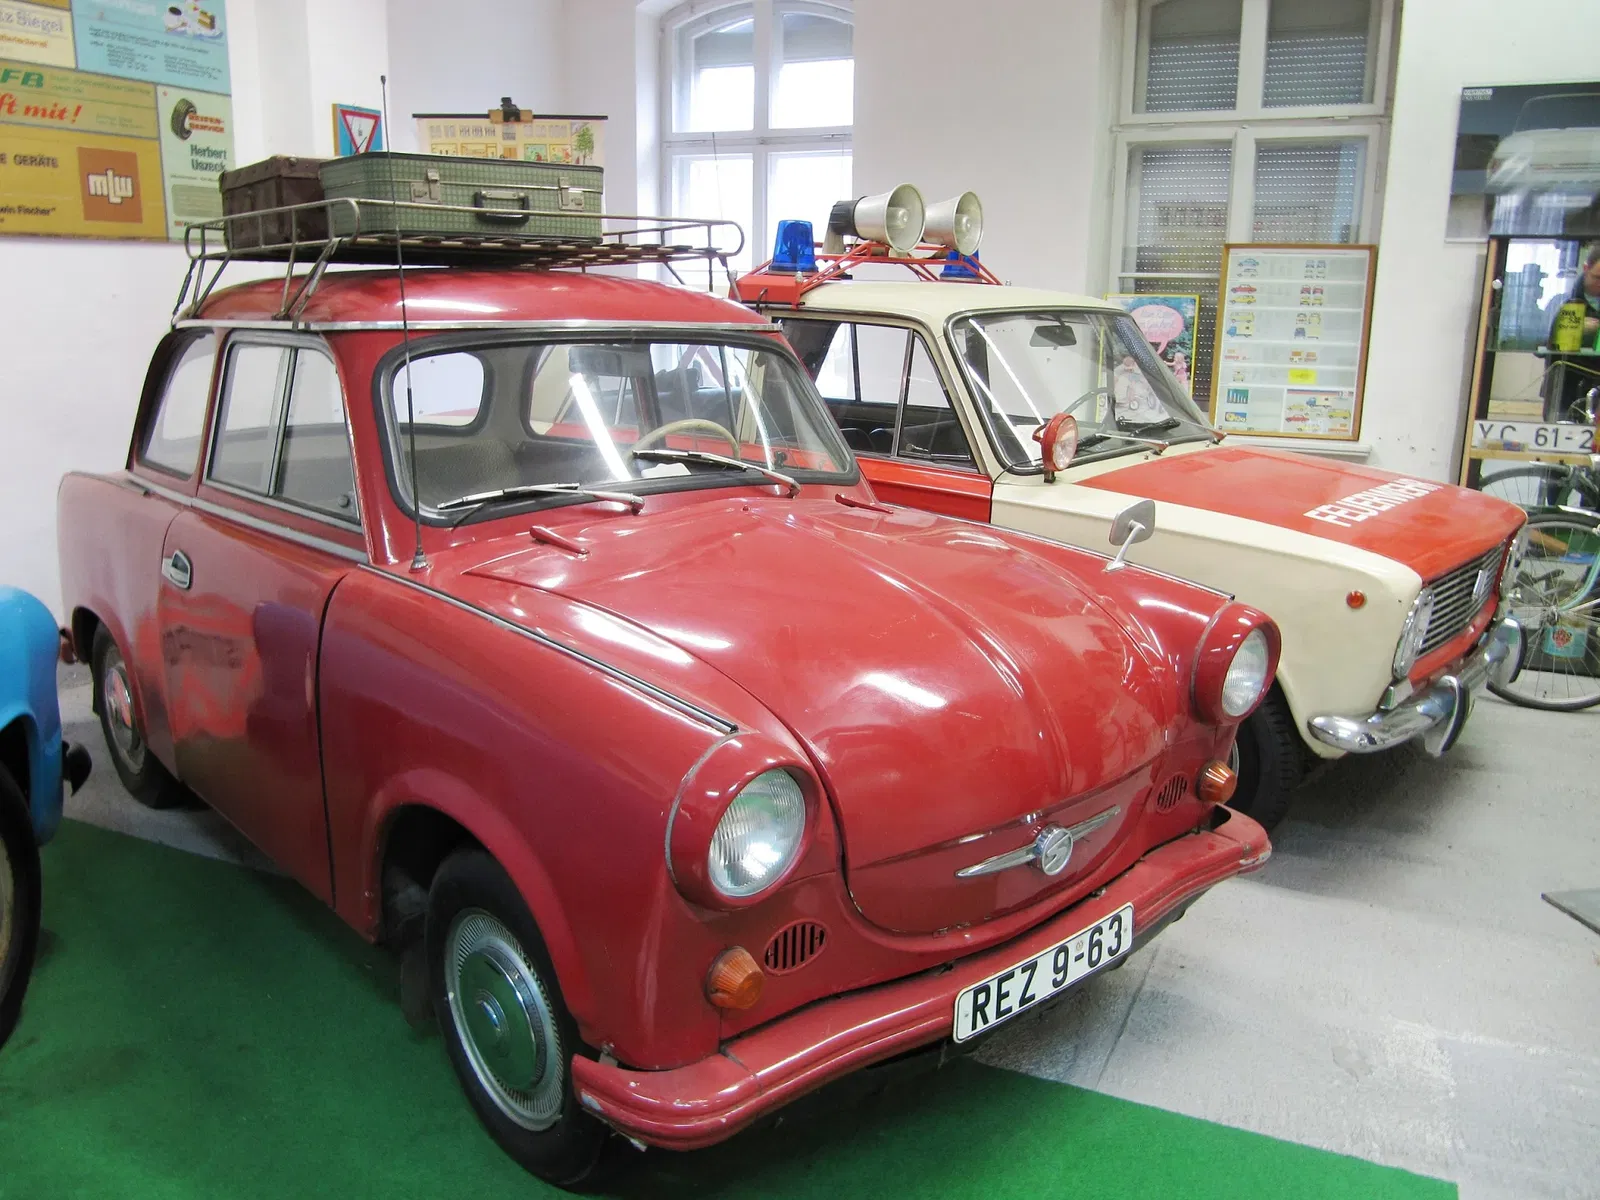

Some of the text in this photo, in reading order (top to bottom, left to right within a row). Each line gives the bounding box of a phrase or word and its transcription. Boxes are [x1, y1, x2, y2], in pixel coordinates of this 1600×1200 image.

[190, 144, 227, 160] Herbert
[1302, 477, 1445, 528] FEUERWEHR
[970, 913, 1123, 1032] REZ 9-63
